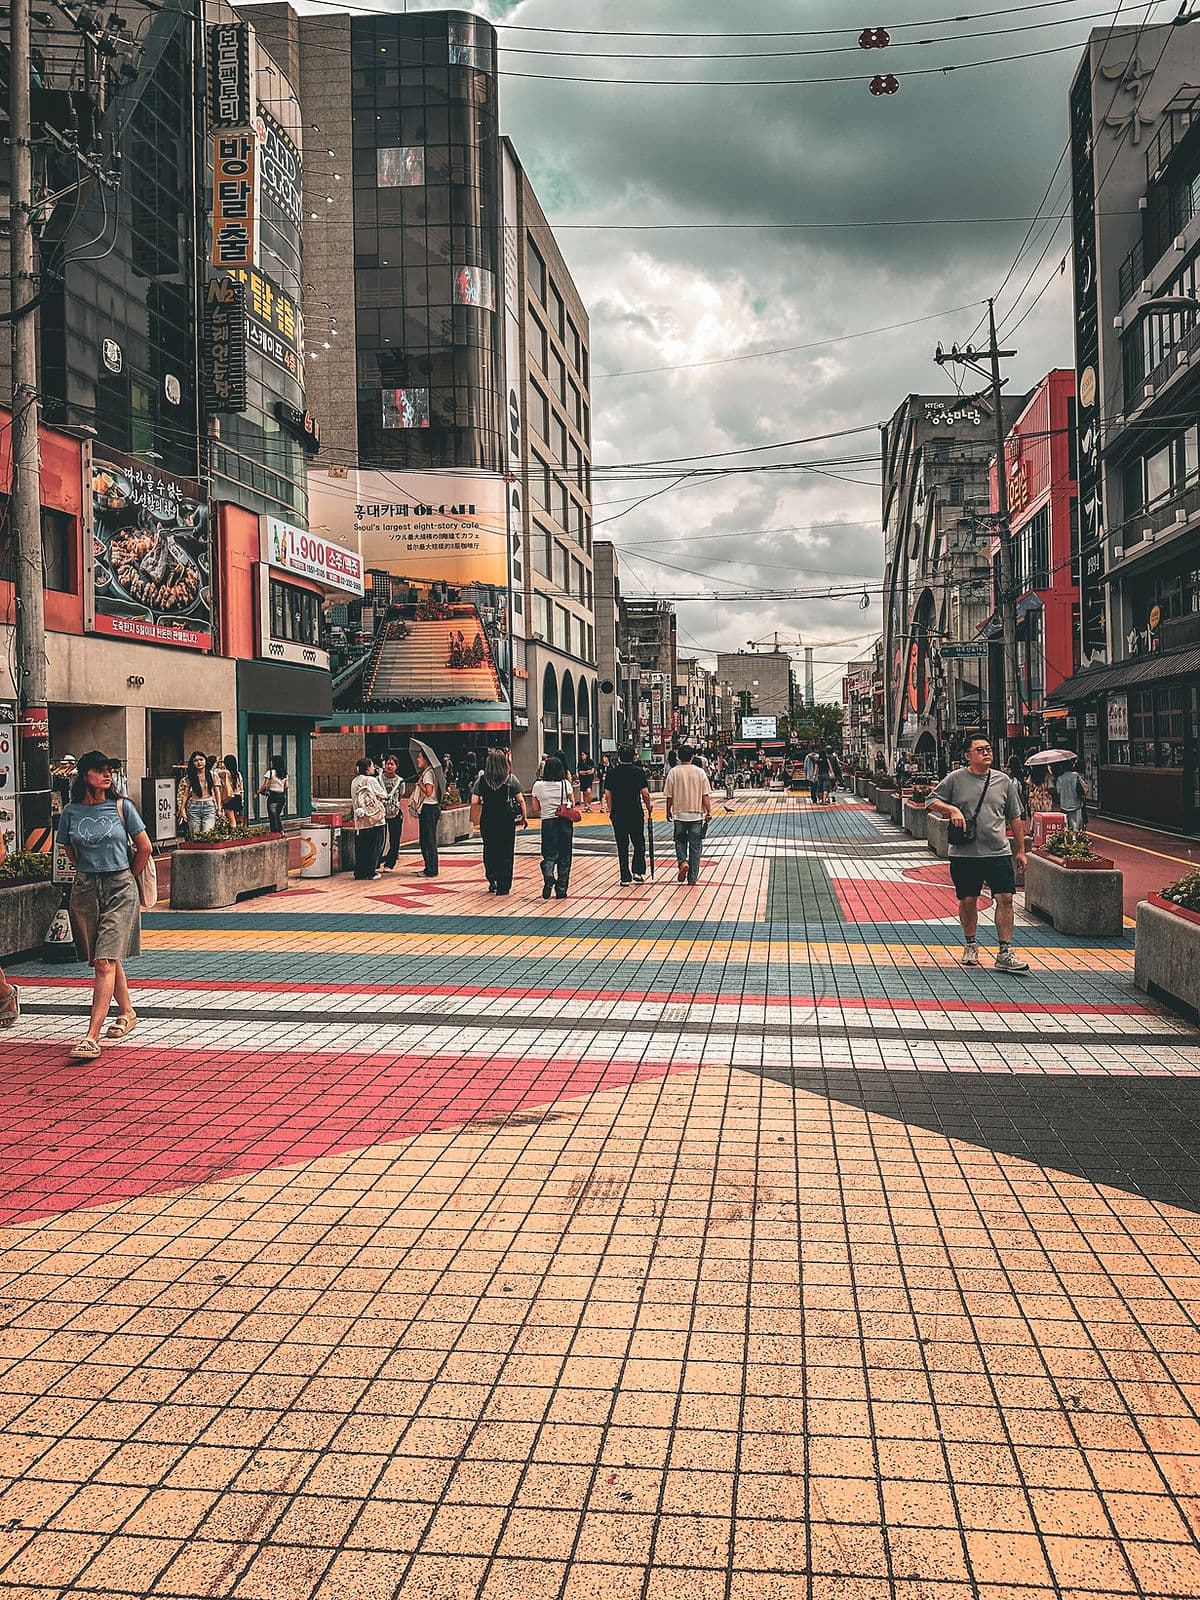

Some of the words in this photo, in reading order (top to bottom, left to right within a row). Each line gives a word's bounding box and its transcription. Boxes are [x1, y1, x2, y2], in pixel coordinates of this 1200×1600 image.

[218, 30, 239, 120] 보드팩토리
[216, 136, 252, 263] 방탈출
[124, 466, 154, 492] 따라올
[156, 478, 166, 496] 수
[167, 481, 184, 502] 없는
[129, 489, 162, 513] 신선함의
[354, 503, 409, 521] 홍대카페
[383, 523, 411, 532] largest
[413, 521, 458, 531] eight-story
[288, 531, 325, 565] 1,900
[158, 812, 171, 821] SALE
